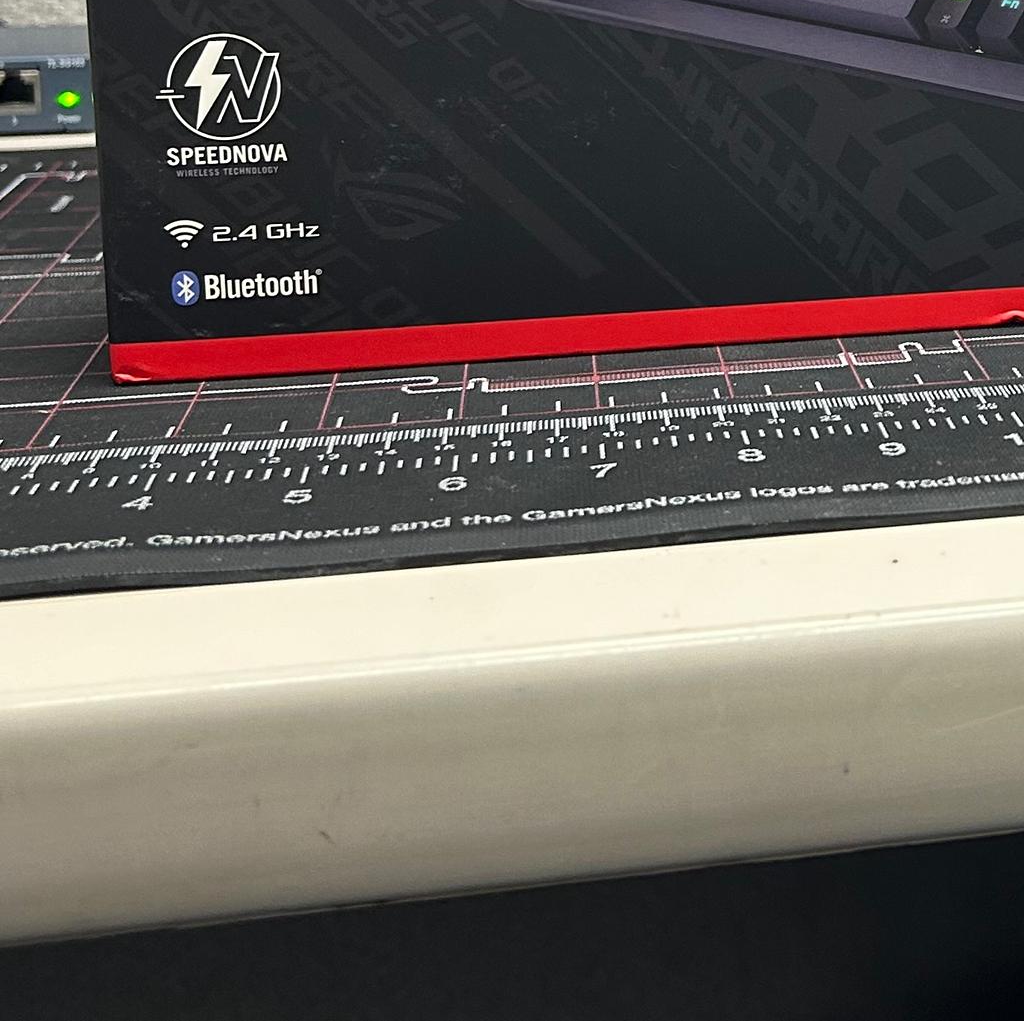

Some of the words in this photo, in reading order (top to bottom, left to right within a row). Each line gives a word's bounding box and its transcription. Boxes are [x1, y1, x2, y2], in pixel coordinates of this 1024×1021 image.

[166, 143, 288, 167] SPEEDNOVA
[176, 168, 220, 178] WIRELESS
[223, 165, 280, 176] TECHNOLOGY
[211, 224, 258, 243] 2.4
[265, 222, 320, 240] GHz
[121, 495, 154, 511] 4
[282, 488, 314, 505] 5
[437, 476, 468, 492] 6
[589, 462, 618, 479] 7
[737, 448, 767, 463] 8
[878, 441, 907, 457] 9
[146, 525, 381, 548] GamersNexus
[390, 515, 452, 533] and
[462, 509, 513, 526] the
[521, 487, 742, 522] GamersNexus
[750, 482, 834, 501] logos
[842, 480, 889, 492] are
